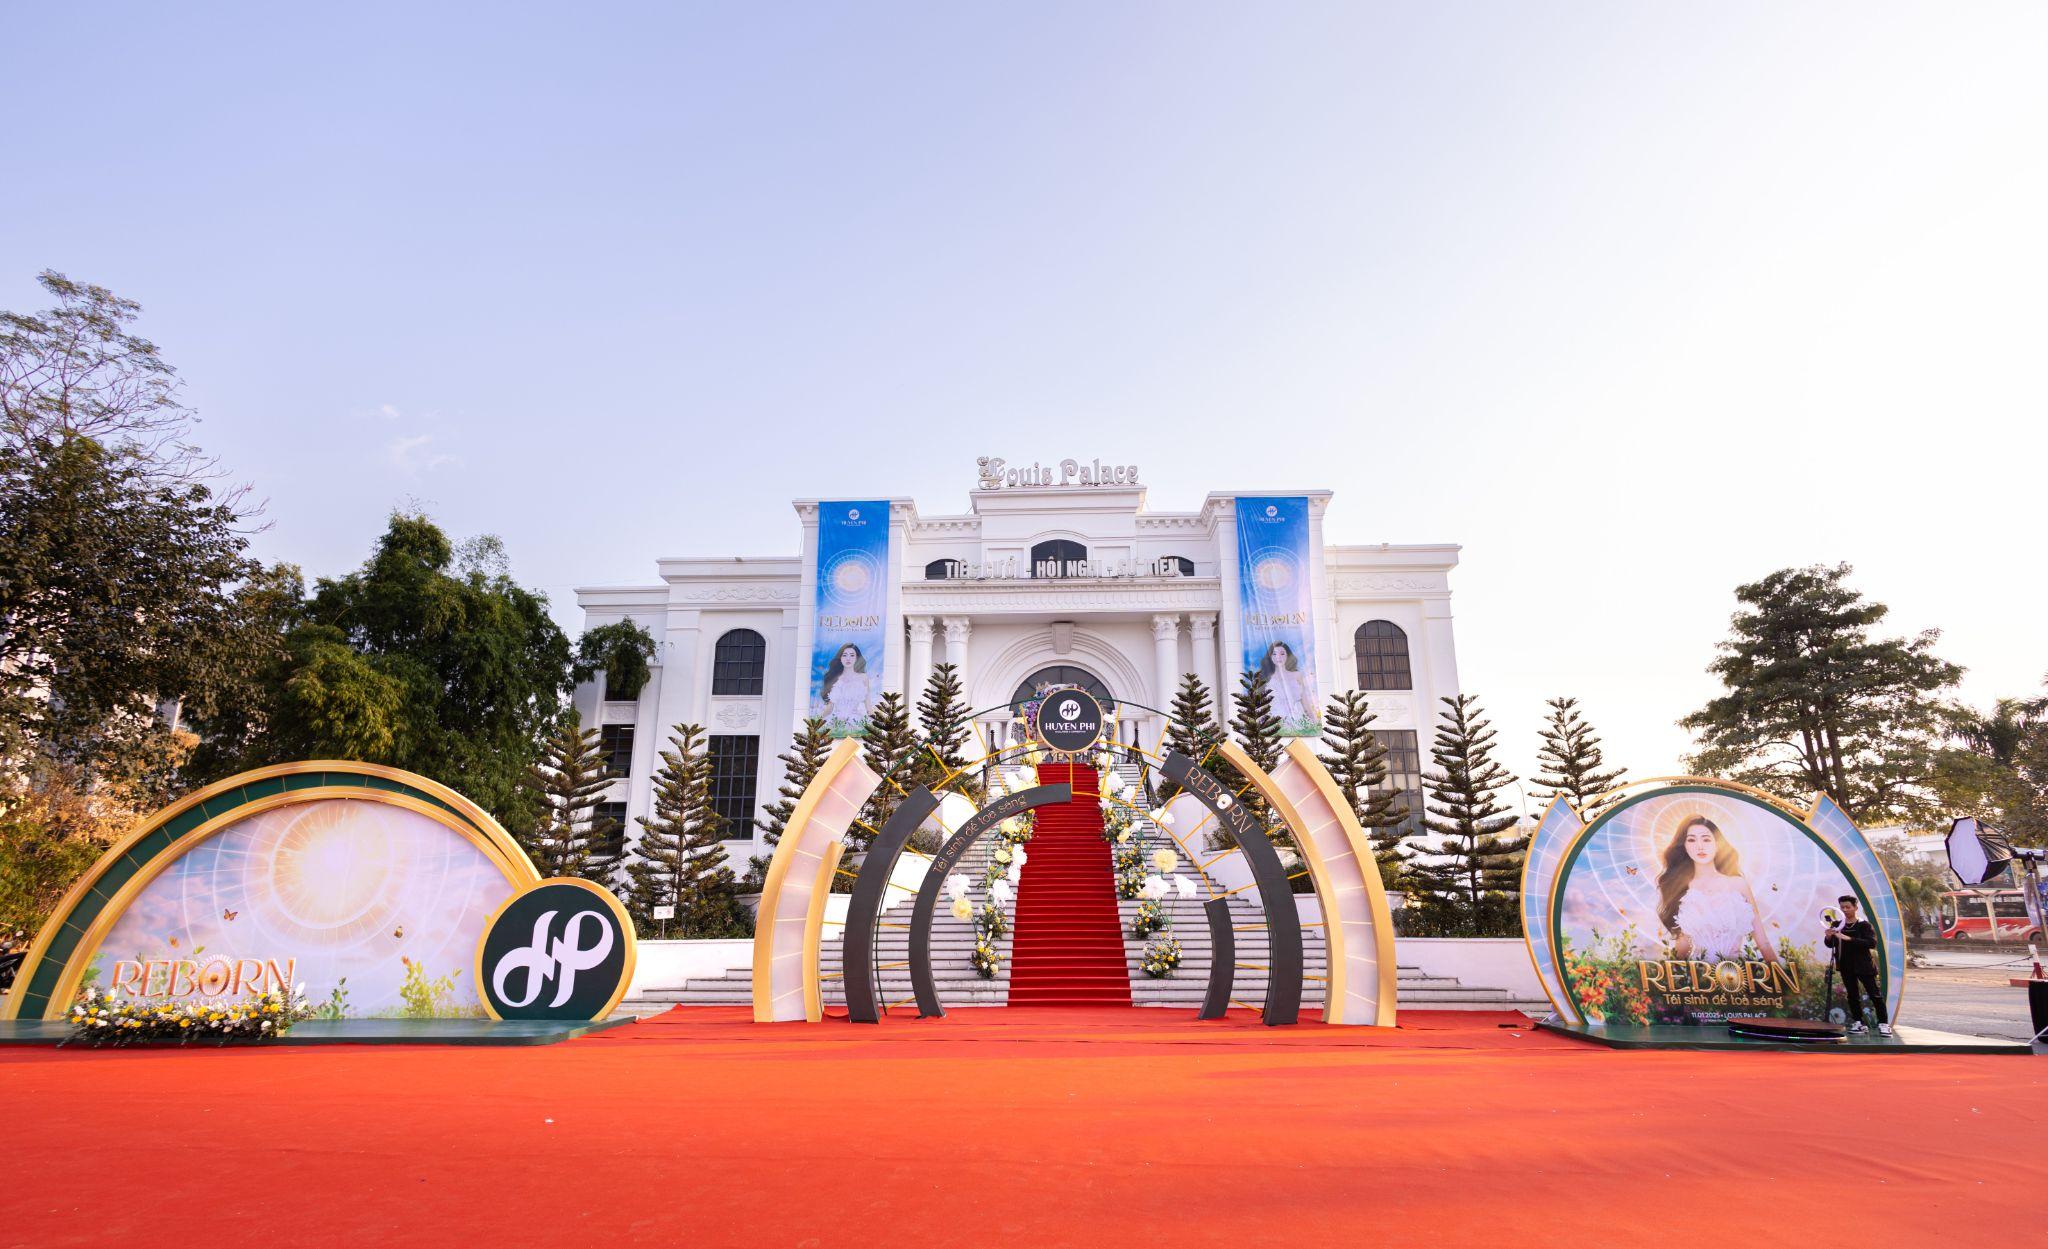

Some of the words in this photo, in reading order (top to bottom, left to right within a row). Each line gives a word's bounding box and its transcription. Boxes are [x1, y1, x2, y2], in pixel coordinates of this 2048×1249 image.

[977, 456, 1053, 490] Louis
[1060, 458, 1139, 486] Palace
[1045, 722, 1077, 731] HUYEN
[1080, 722, 1095, 730] PHI
[1184, 767, 1254, 834] REBORN
[111, 956, 297, 997] REBORN
[1638, 959, 1801, 994] REBORN
[1684, 994, 1709, 1005] sinh
[1753, 995, 1784, 1009] sáng
